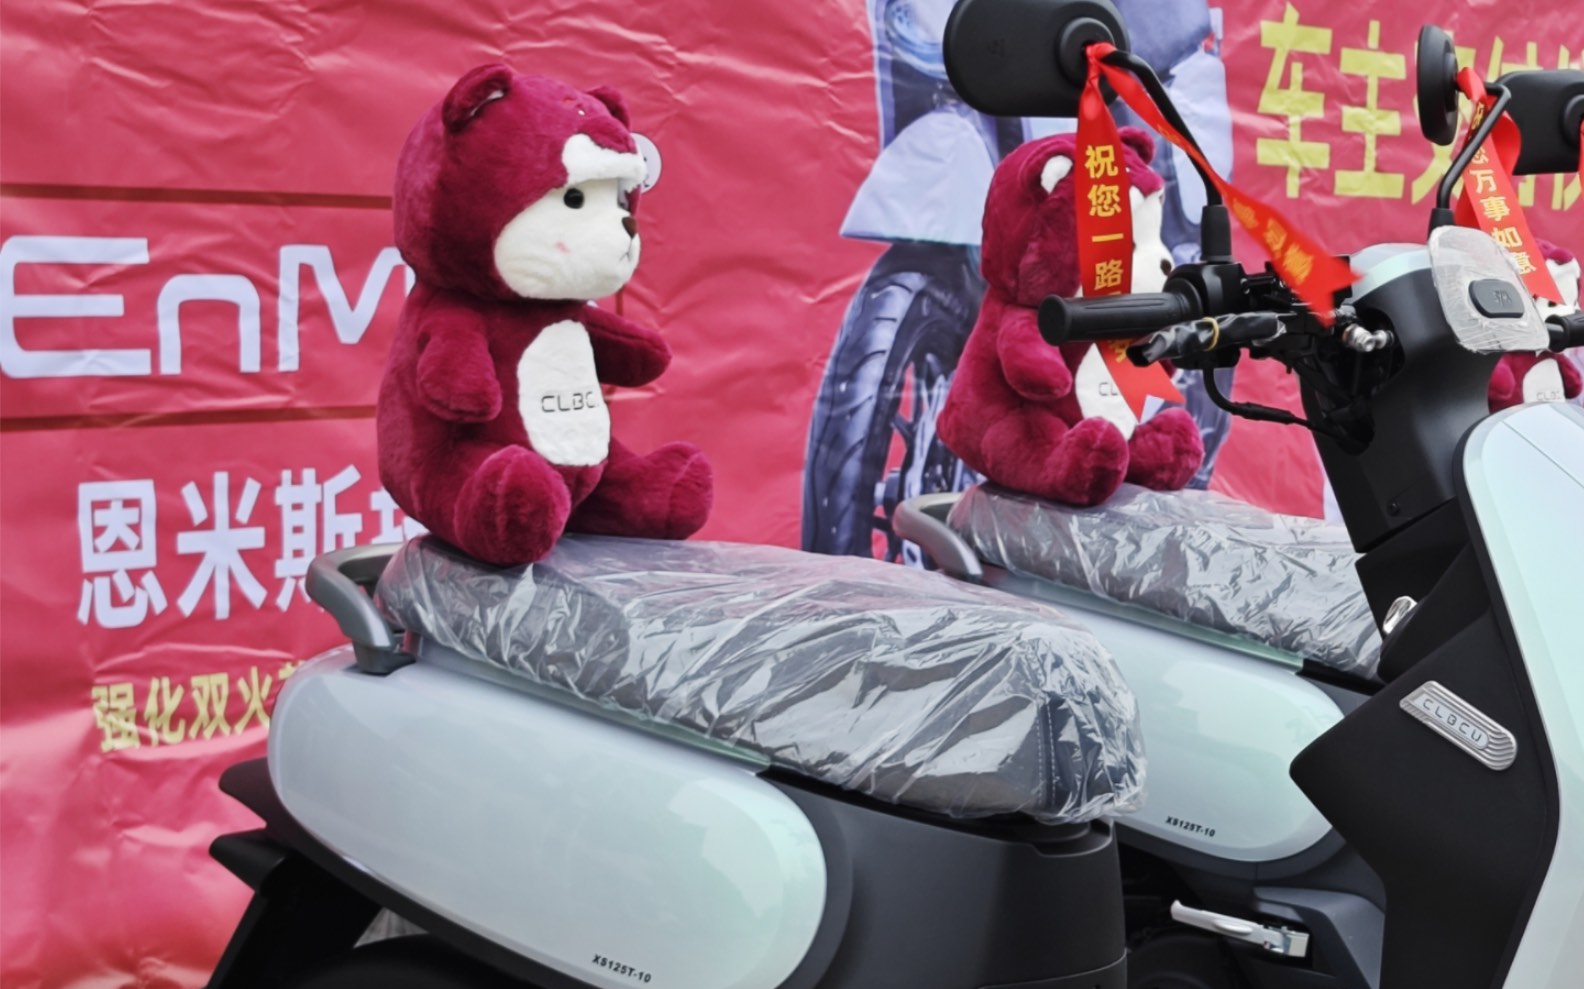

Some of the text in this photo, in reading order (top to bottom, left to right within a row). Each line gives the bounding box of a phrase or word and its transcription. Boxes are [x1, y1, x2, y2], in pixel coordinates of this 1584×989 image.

[91, 660, 304, 753] 强化双火
[1422, 698, 1482, 742] CLBCU
[592, 953, 652, 983] XS125T-10
